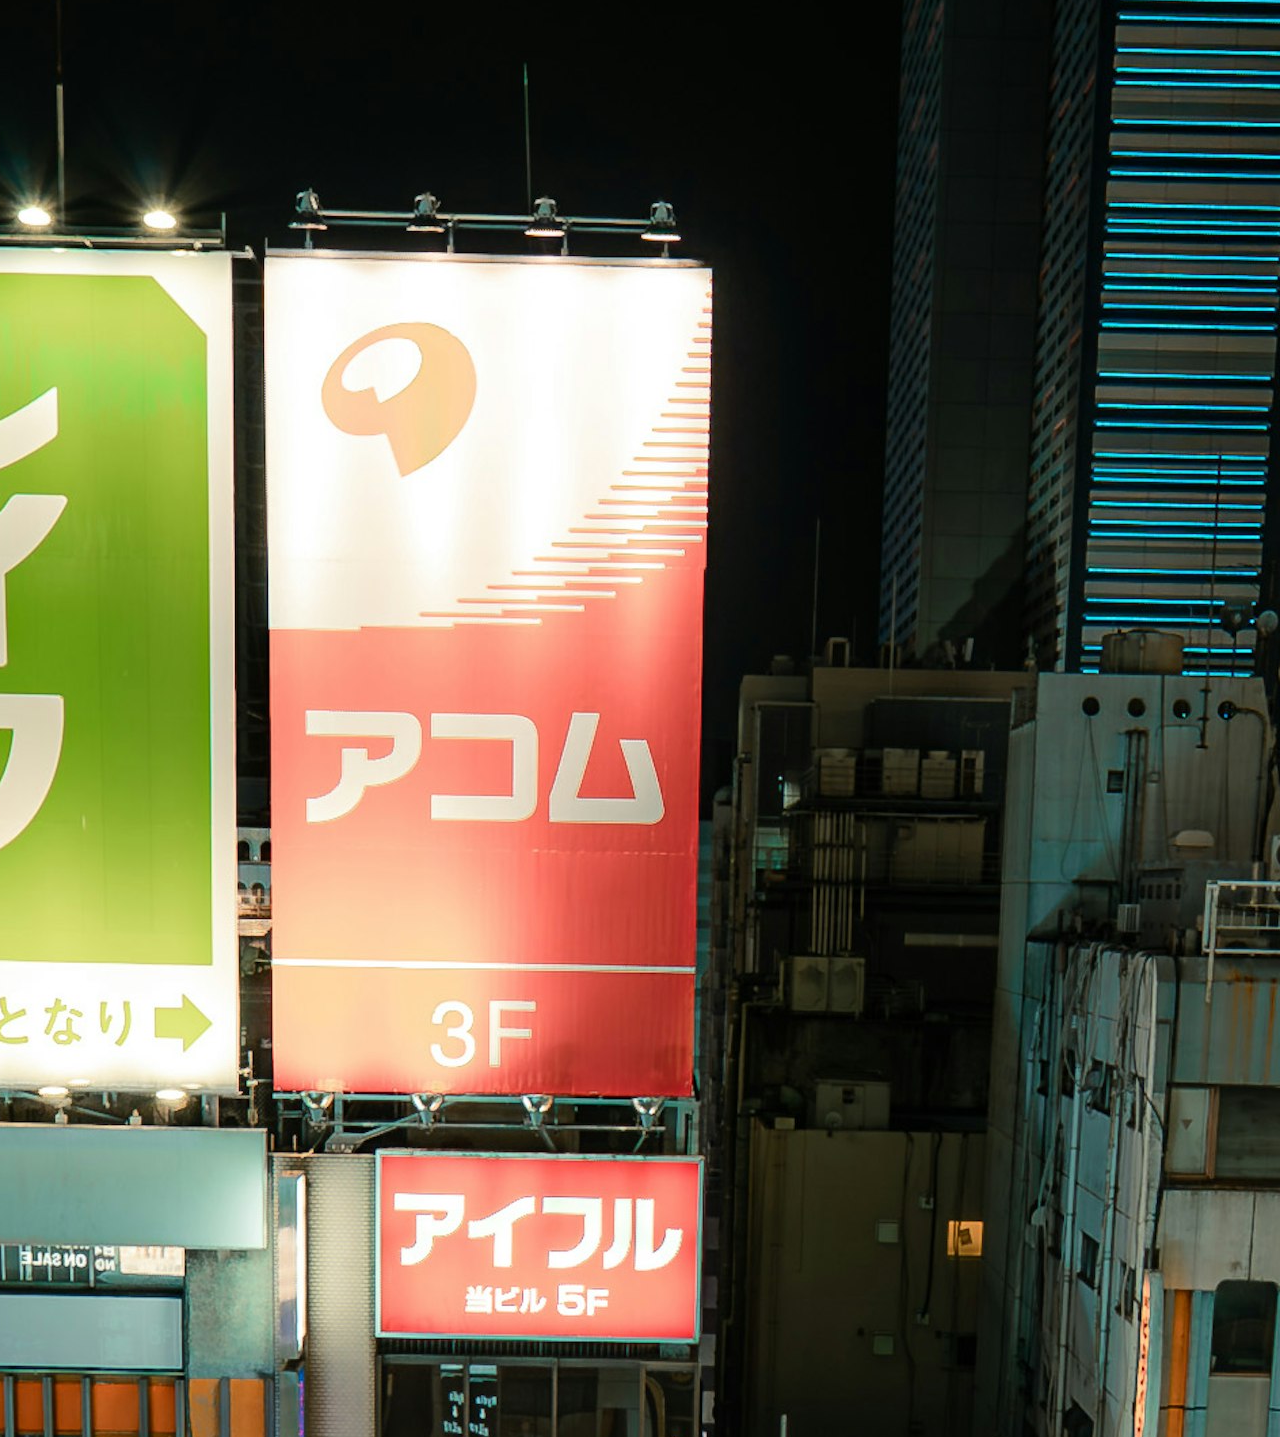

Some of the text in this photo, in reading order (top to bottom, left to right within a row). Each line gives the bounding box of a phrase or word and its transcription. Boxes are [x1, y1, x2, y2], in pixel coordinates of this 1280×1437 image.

[304, 709, 666, 825] アコム
[429, 997, 538, 1069] 3F
[393, 1192, 684, 1273] アイフル
[464, 1284, 609, 1318] 当ビル 5F
